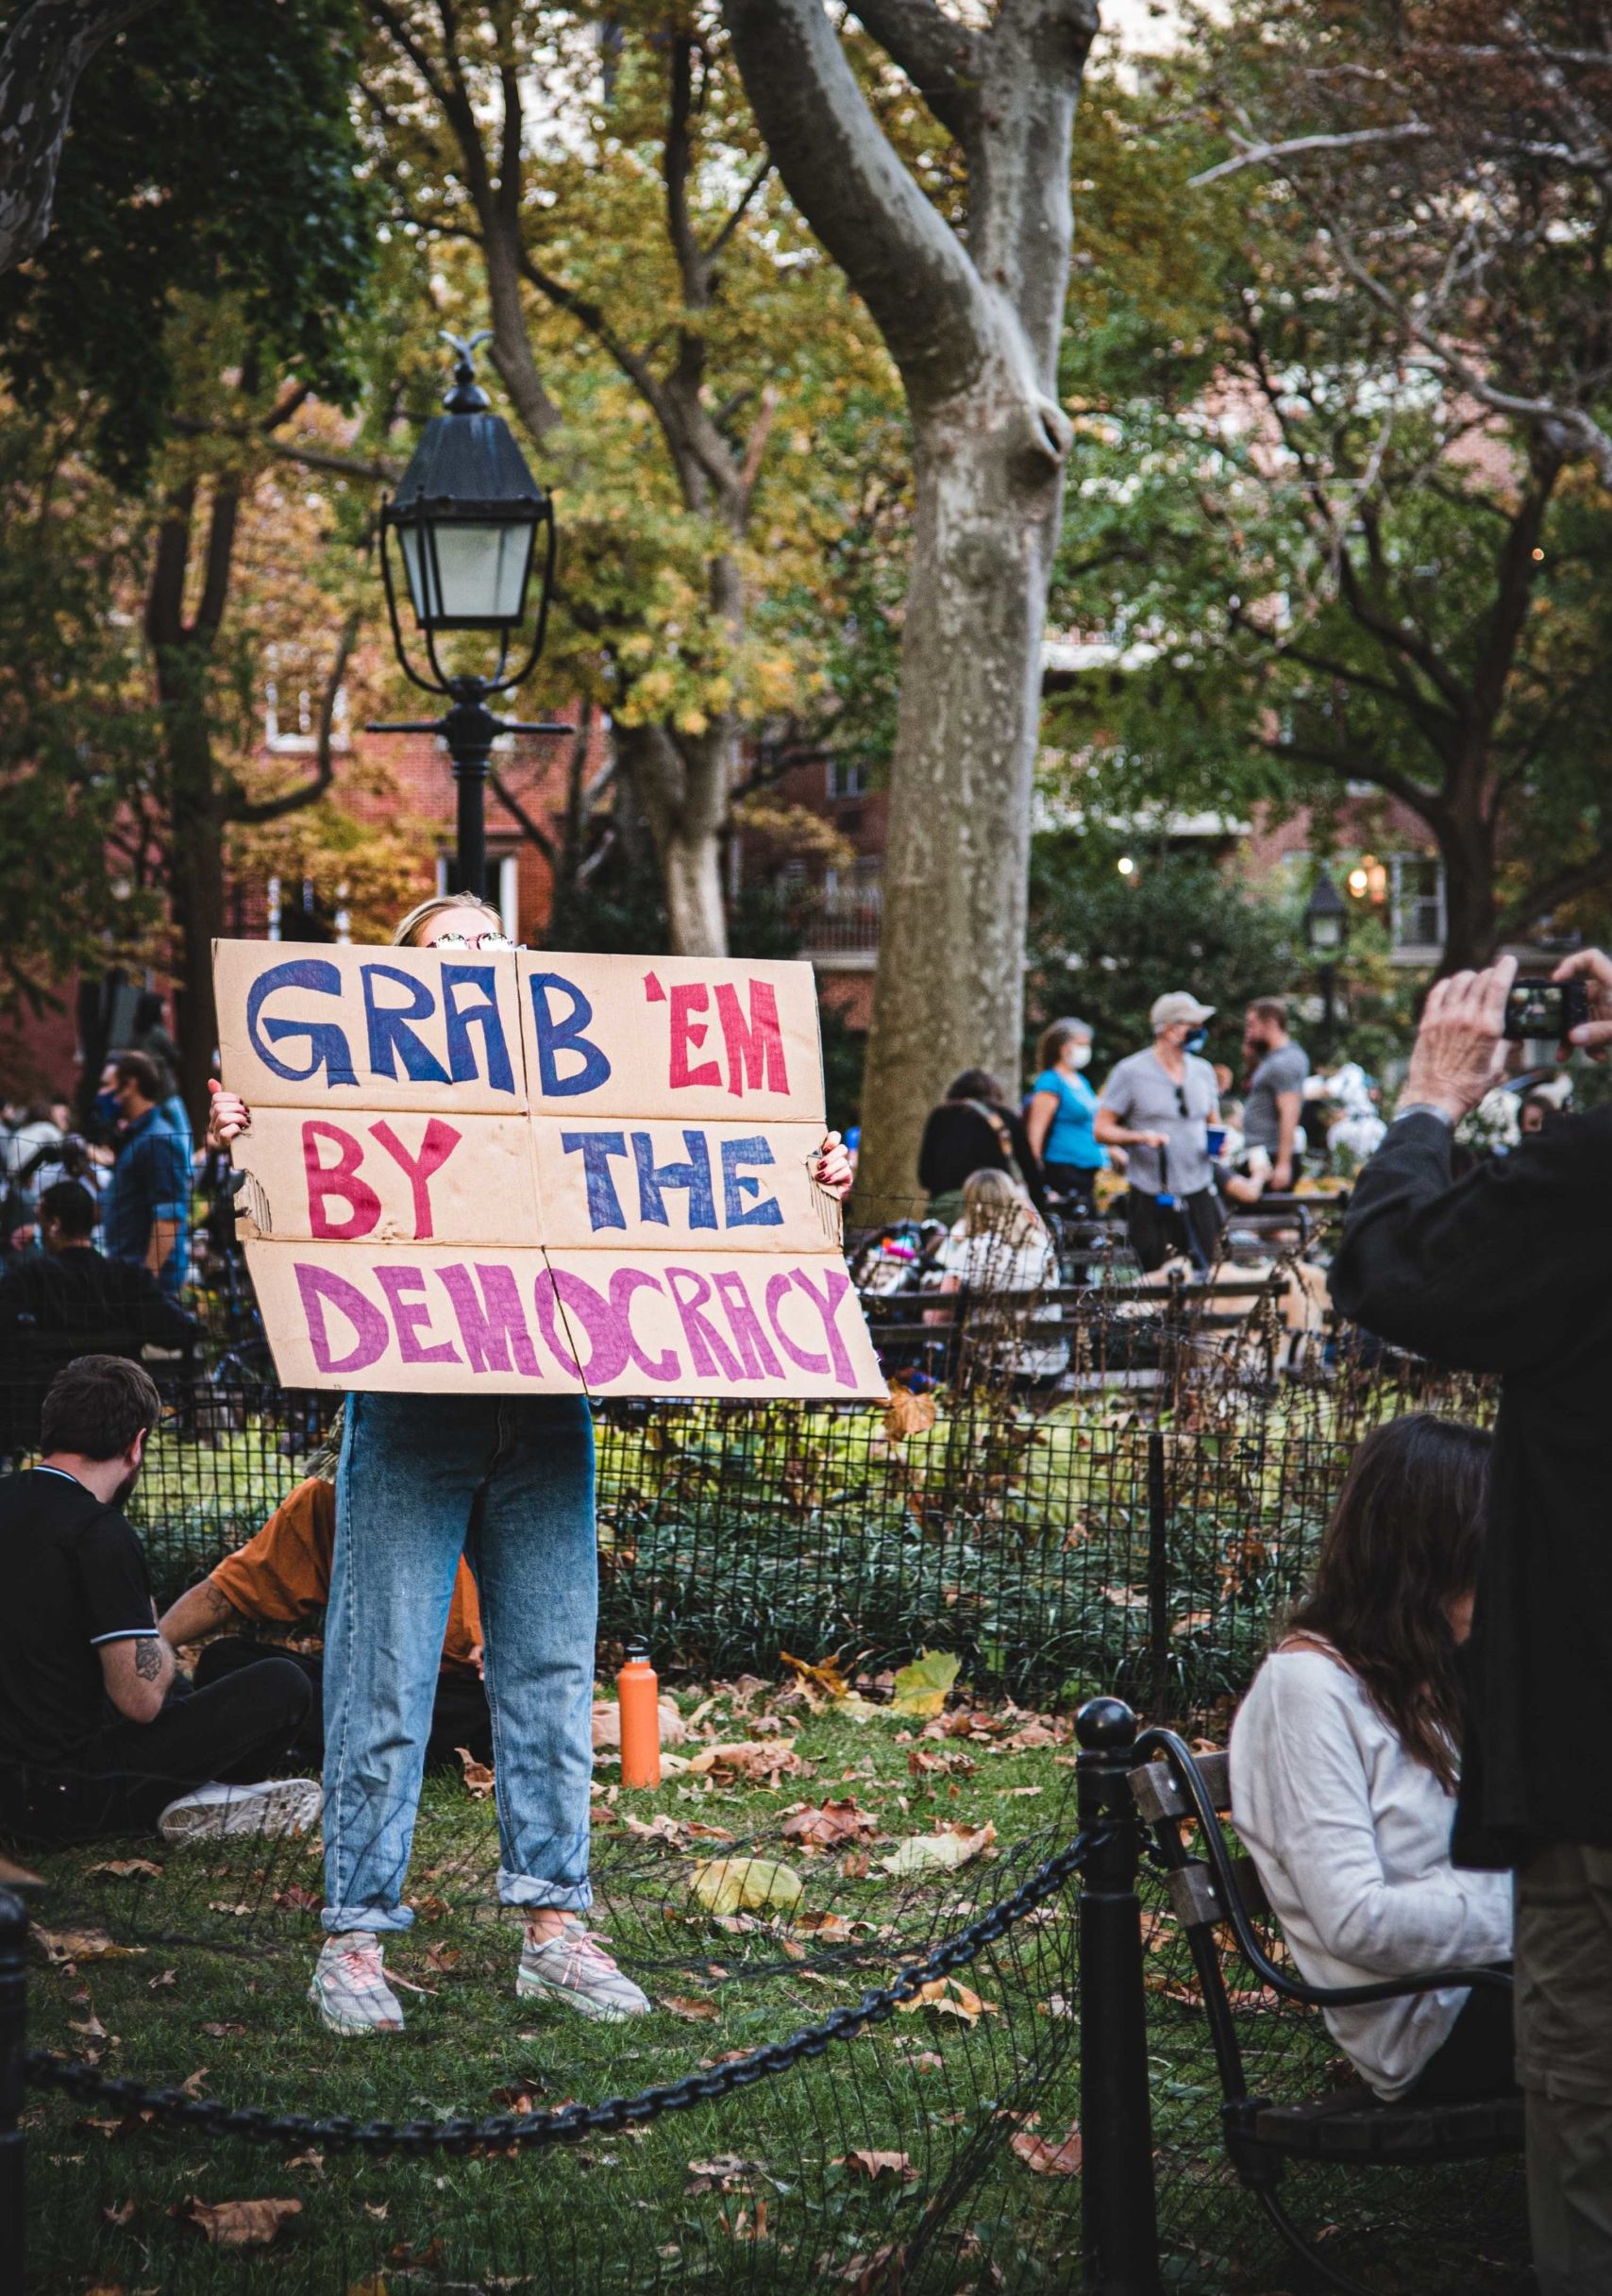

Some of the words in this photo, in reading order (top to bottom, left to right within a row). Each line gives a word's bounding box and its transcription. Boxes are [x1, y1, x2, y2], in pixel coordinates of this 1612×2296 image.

[246, 959, 611, 1097] GRAB
[645, 971, 791, 1097] 'EM
[301, 1118, 462, 1240] BY
[562, 1130, 784, 1232] THE
[294, 1263, 859, 1389] DEMOCRACY
